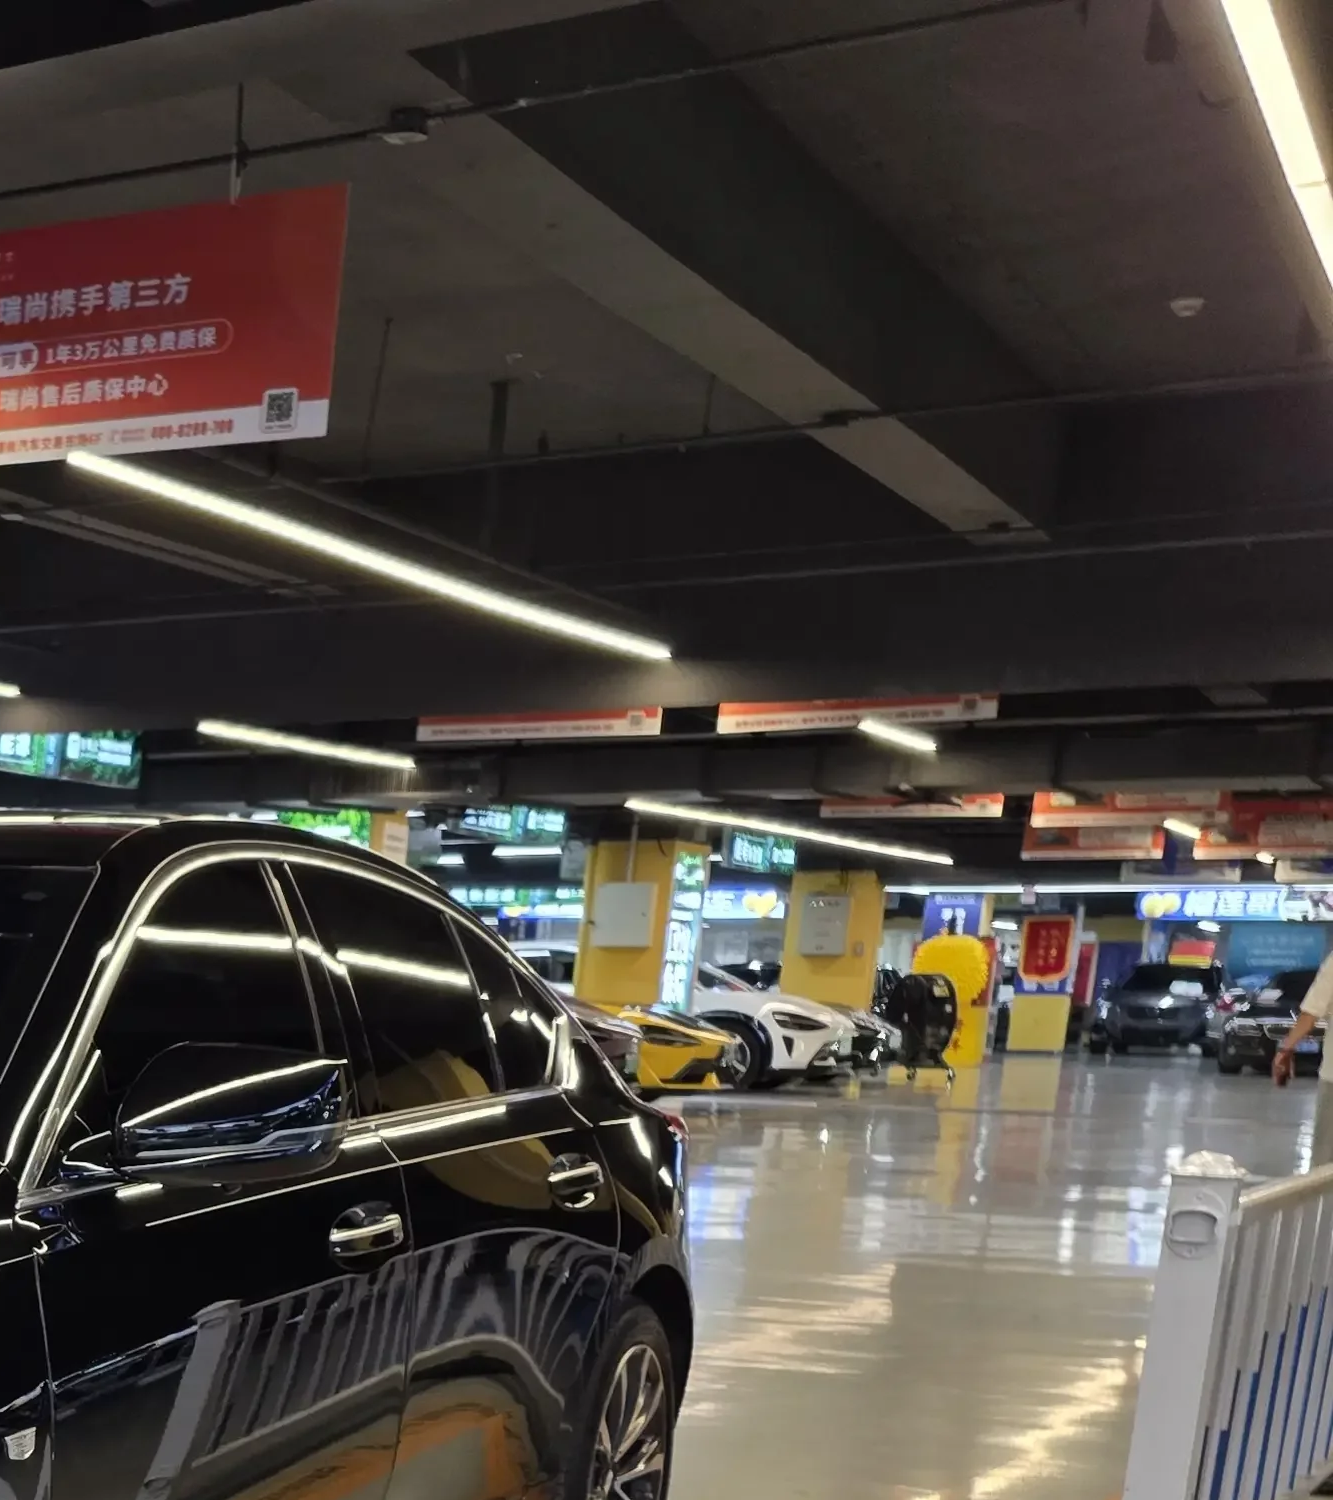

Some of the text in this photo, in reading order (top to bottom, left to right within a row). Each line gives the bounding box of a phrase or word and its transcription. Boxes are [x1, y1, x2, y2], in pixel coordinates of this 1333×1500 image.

[45, 326, 218, 365] 1年3万公里免费质保
